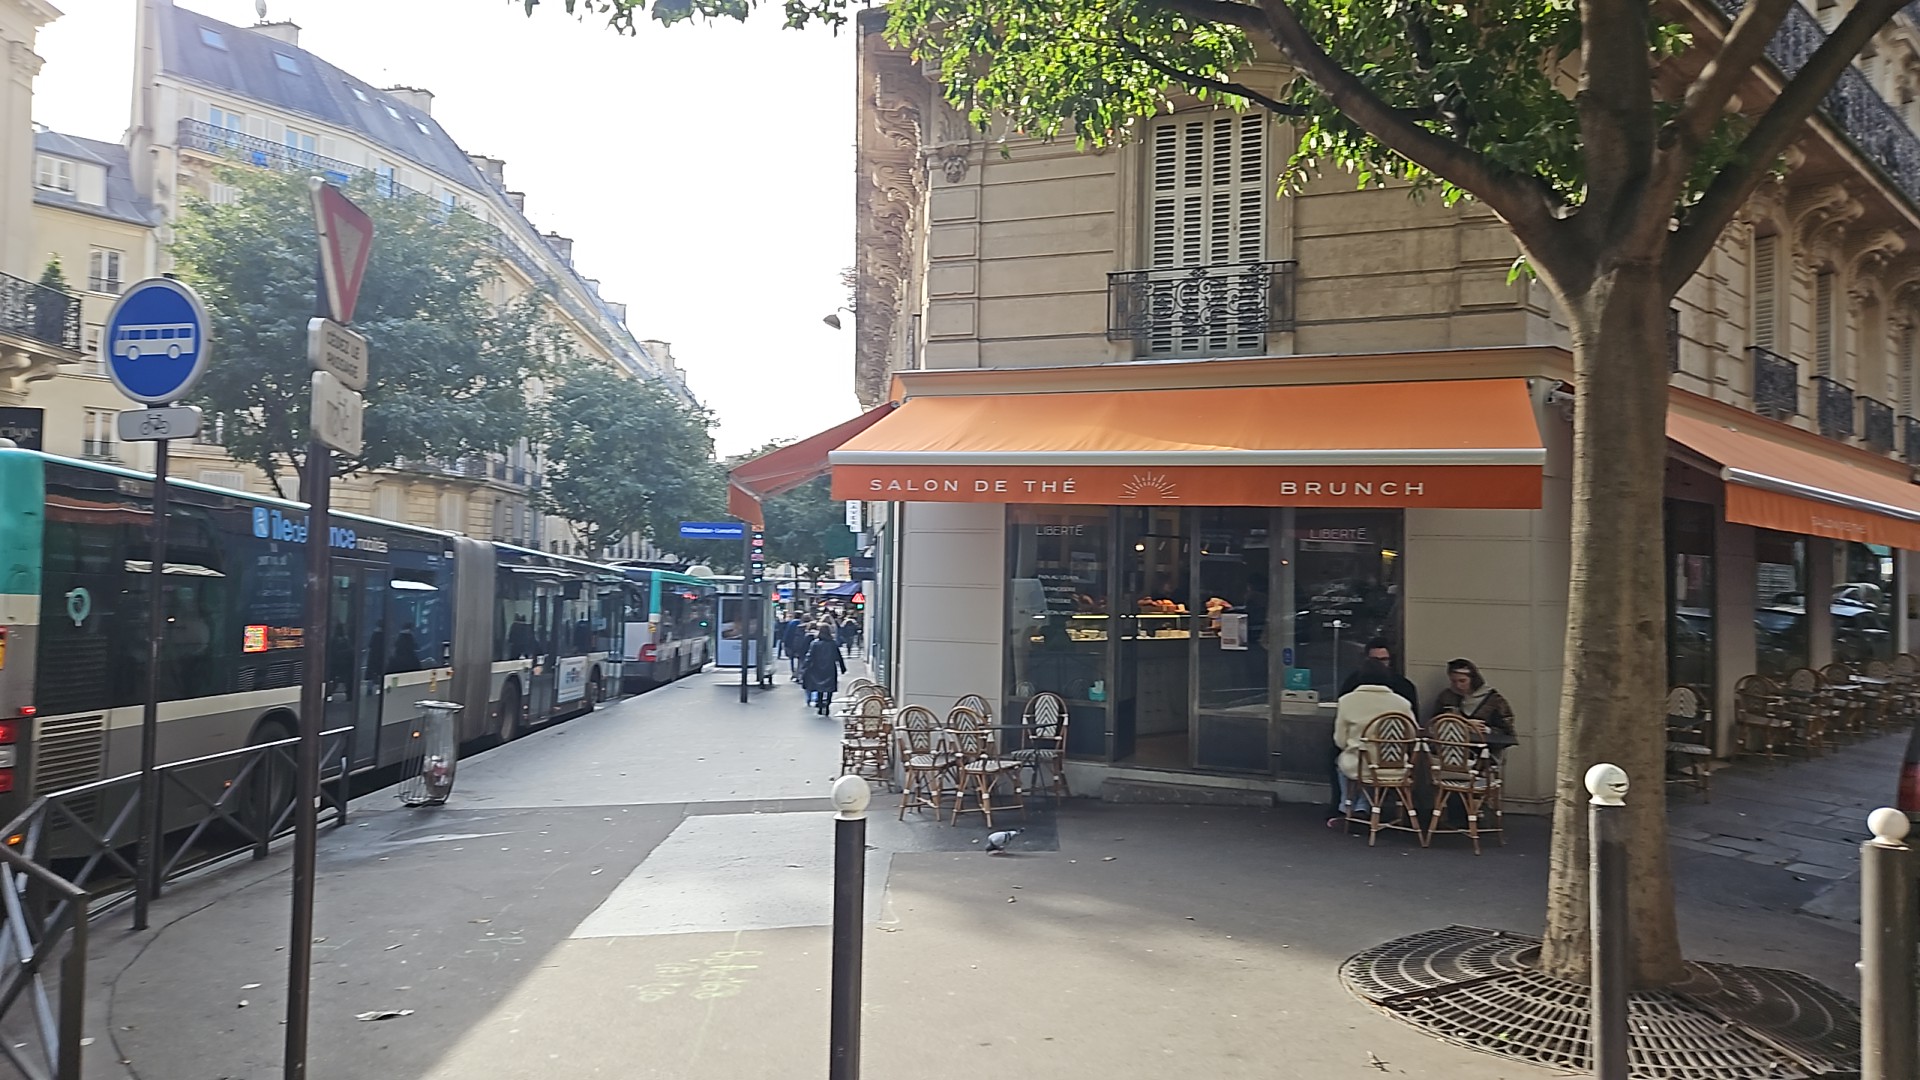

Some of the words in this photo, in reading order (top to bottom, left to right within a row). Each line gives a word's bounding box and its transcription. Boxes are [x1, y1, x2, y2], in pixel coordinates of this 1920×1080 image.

[869, 478, 958, 492] SALON
[974, 480, 1007, 493] DE
[1023, 477, 1076, 493] THÉ
[1280, 481, 1424, 495] BRUNCH
[1036, 524, 1084, 536] LIBERTÉ
[1309, 527, 1367, 540] LIBERTÉ
